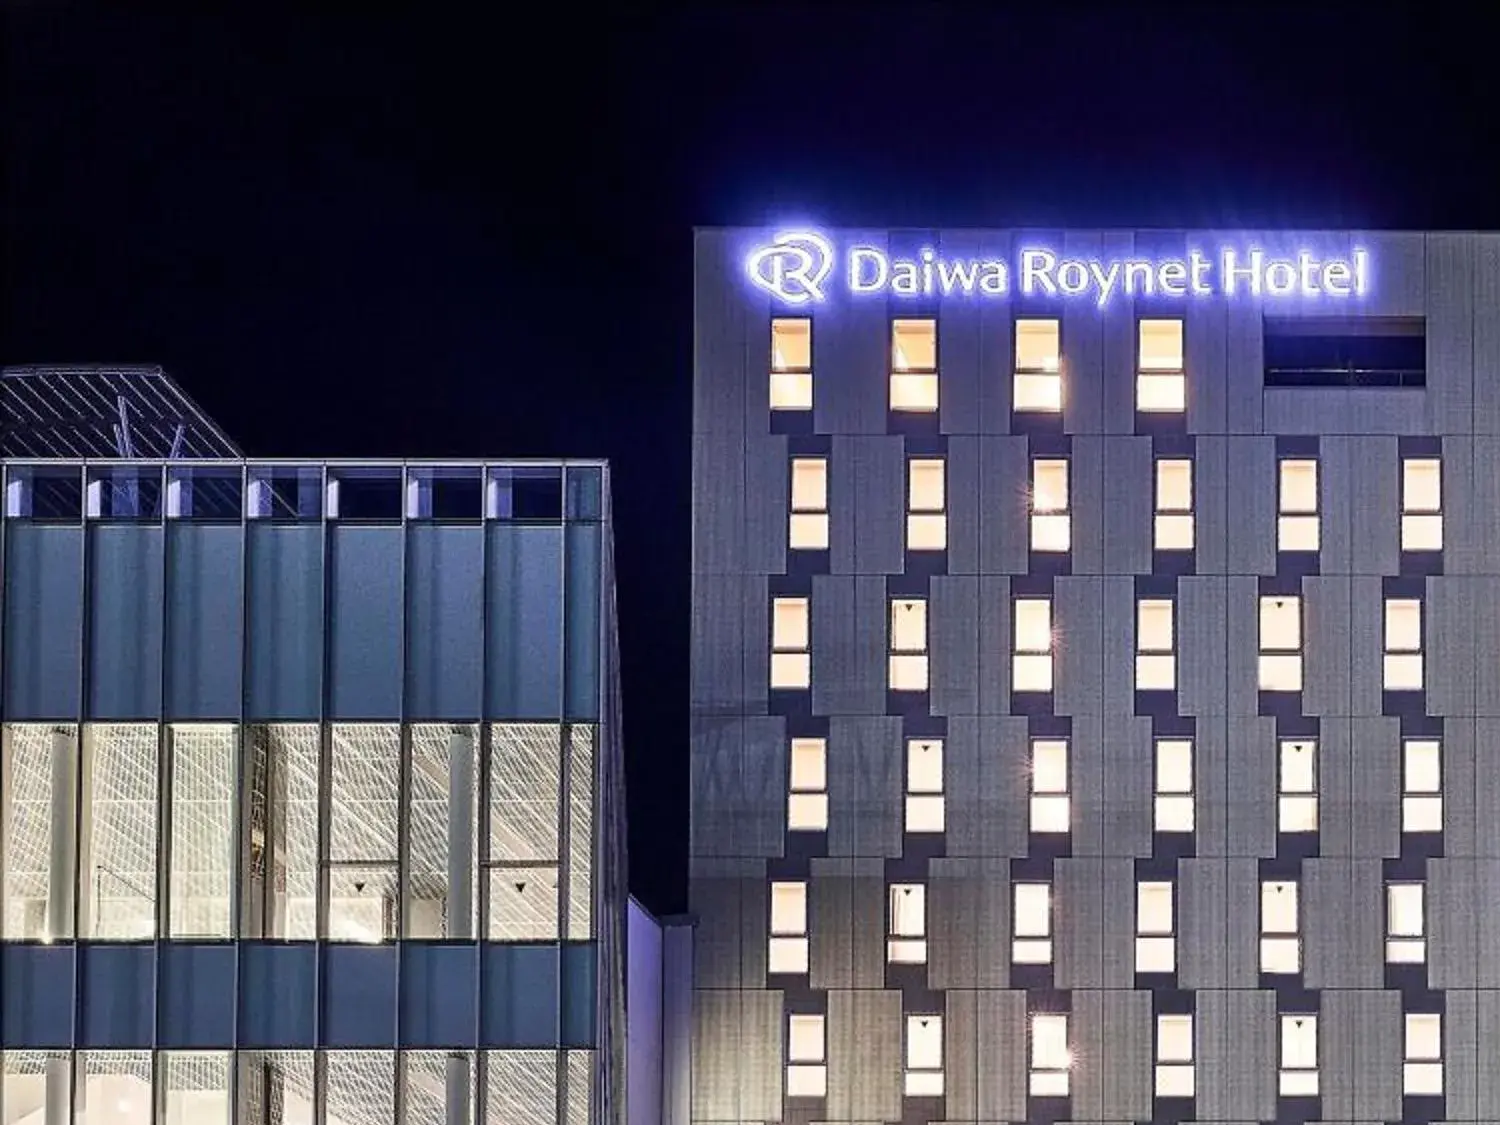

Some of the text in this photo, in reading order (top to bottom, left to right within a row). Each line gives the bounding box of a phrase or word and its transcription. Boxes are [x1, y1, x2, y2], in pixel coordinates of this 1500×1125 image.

[850, 248, 1006, 296] Daiwa
[1021, 248, 1211, 307] Roynet
[1224, 248, 1368, 296] Hotel
